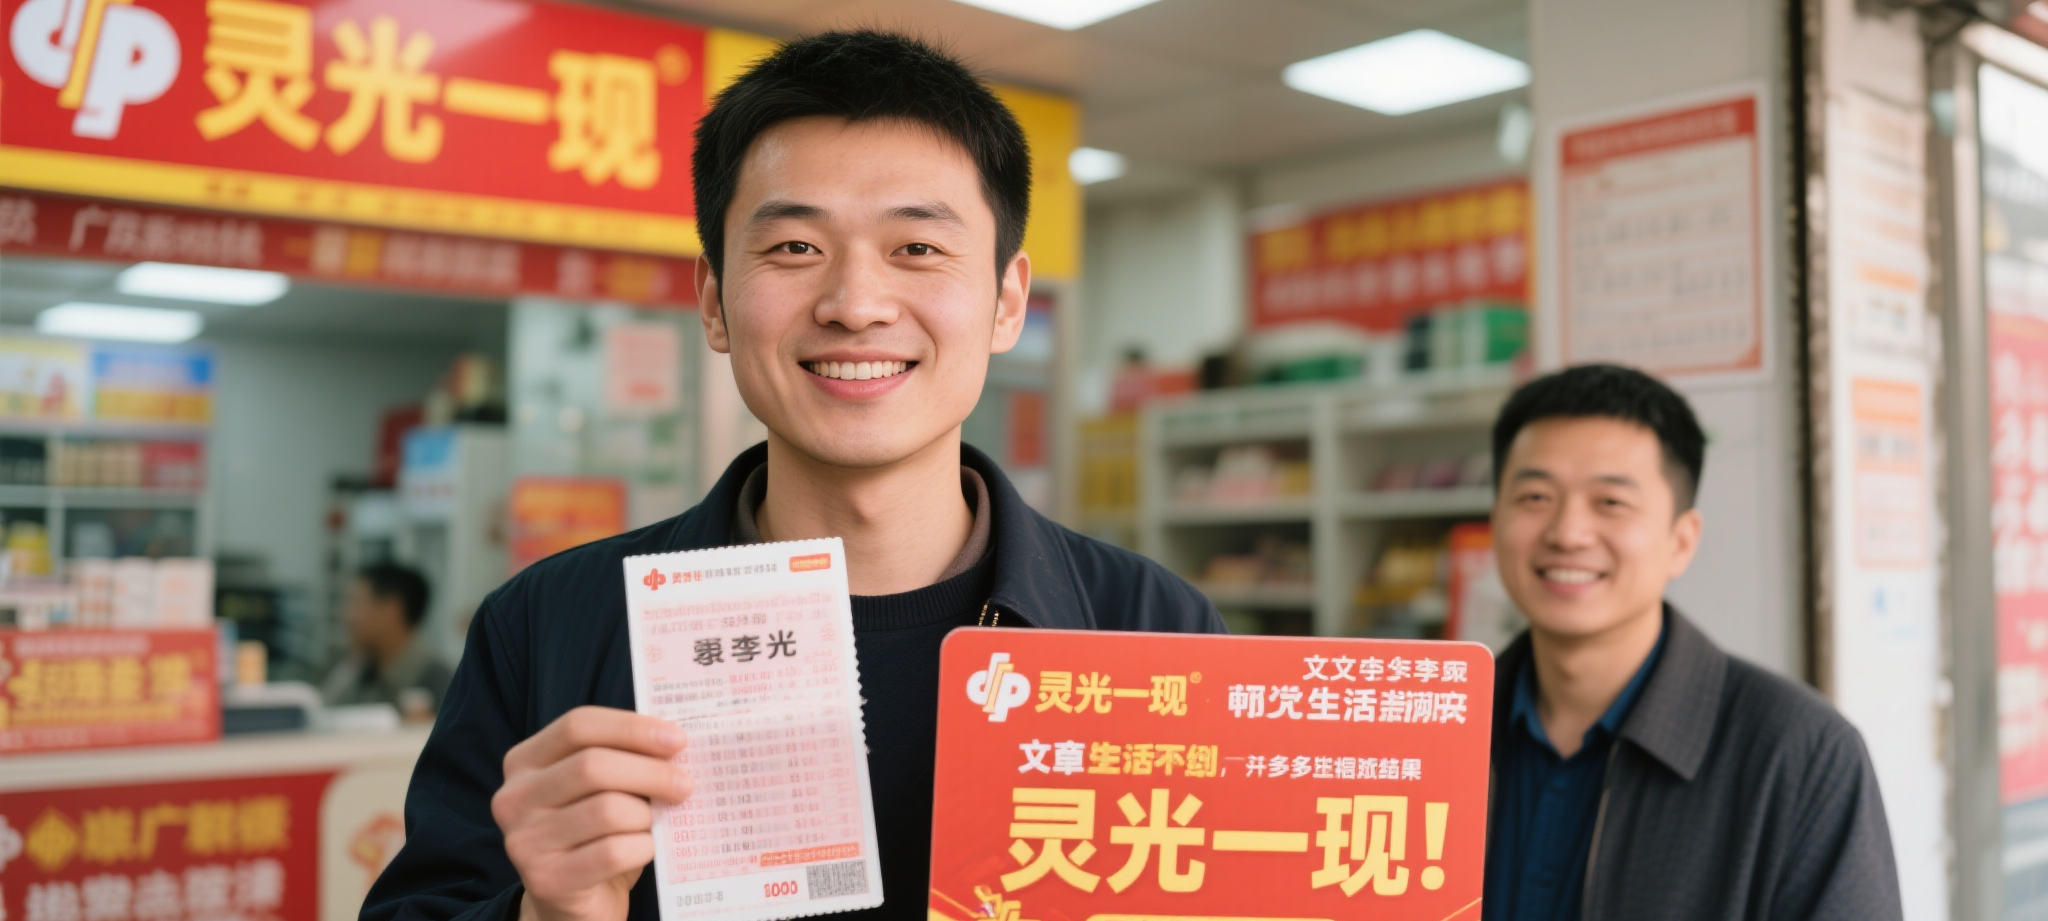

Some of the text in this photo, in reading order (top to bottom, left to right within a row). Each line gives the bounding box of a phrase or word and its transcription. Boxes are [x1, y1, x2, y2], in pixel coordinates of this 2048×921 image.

[195, 2, 662, 191] 灵光一现
[1034, 670, 1188, 717] 灵光一现
[1000, 787, 1451, 898] 灵光一现!
